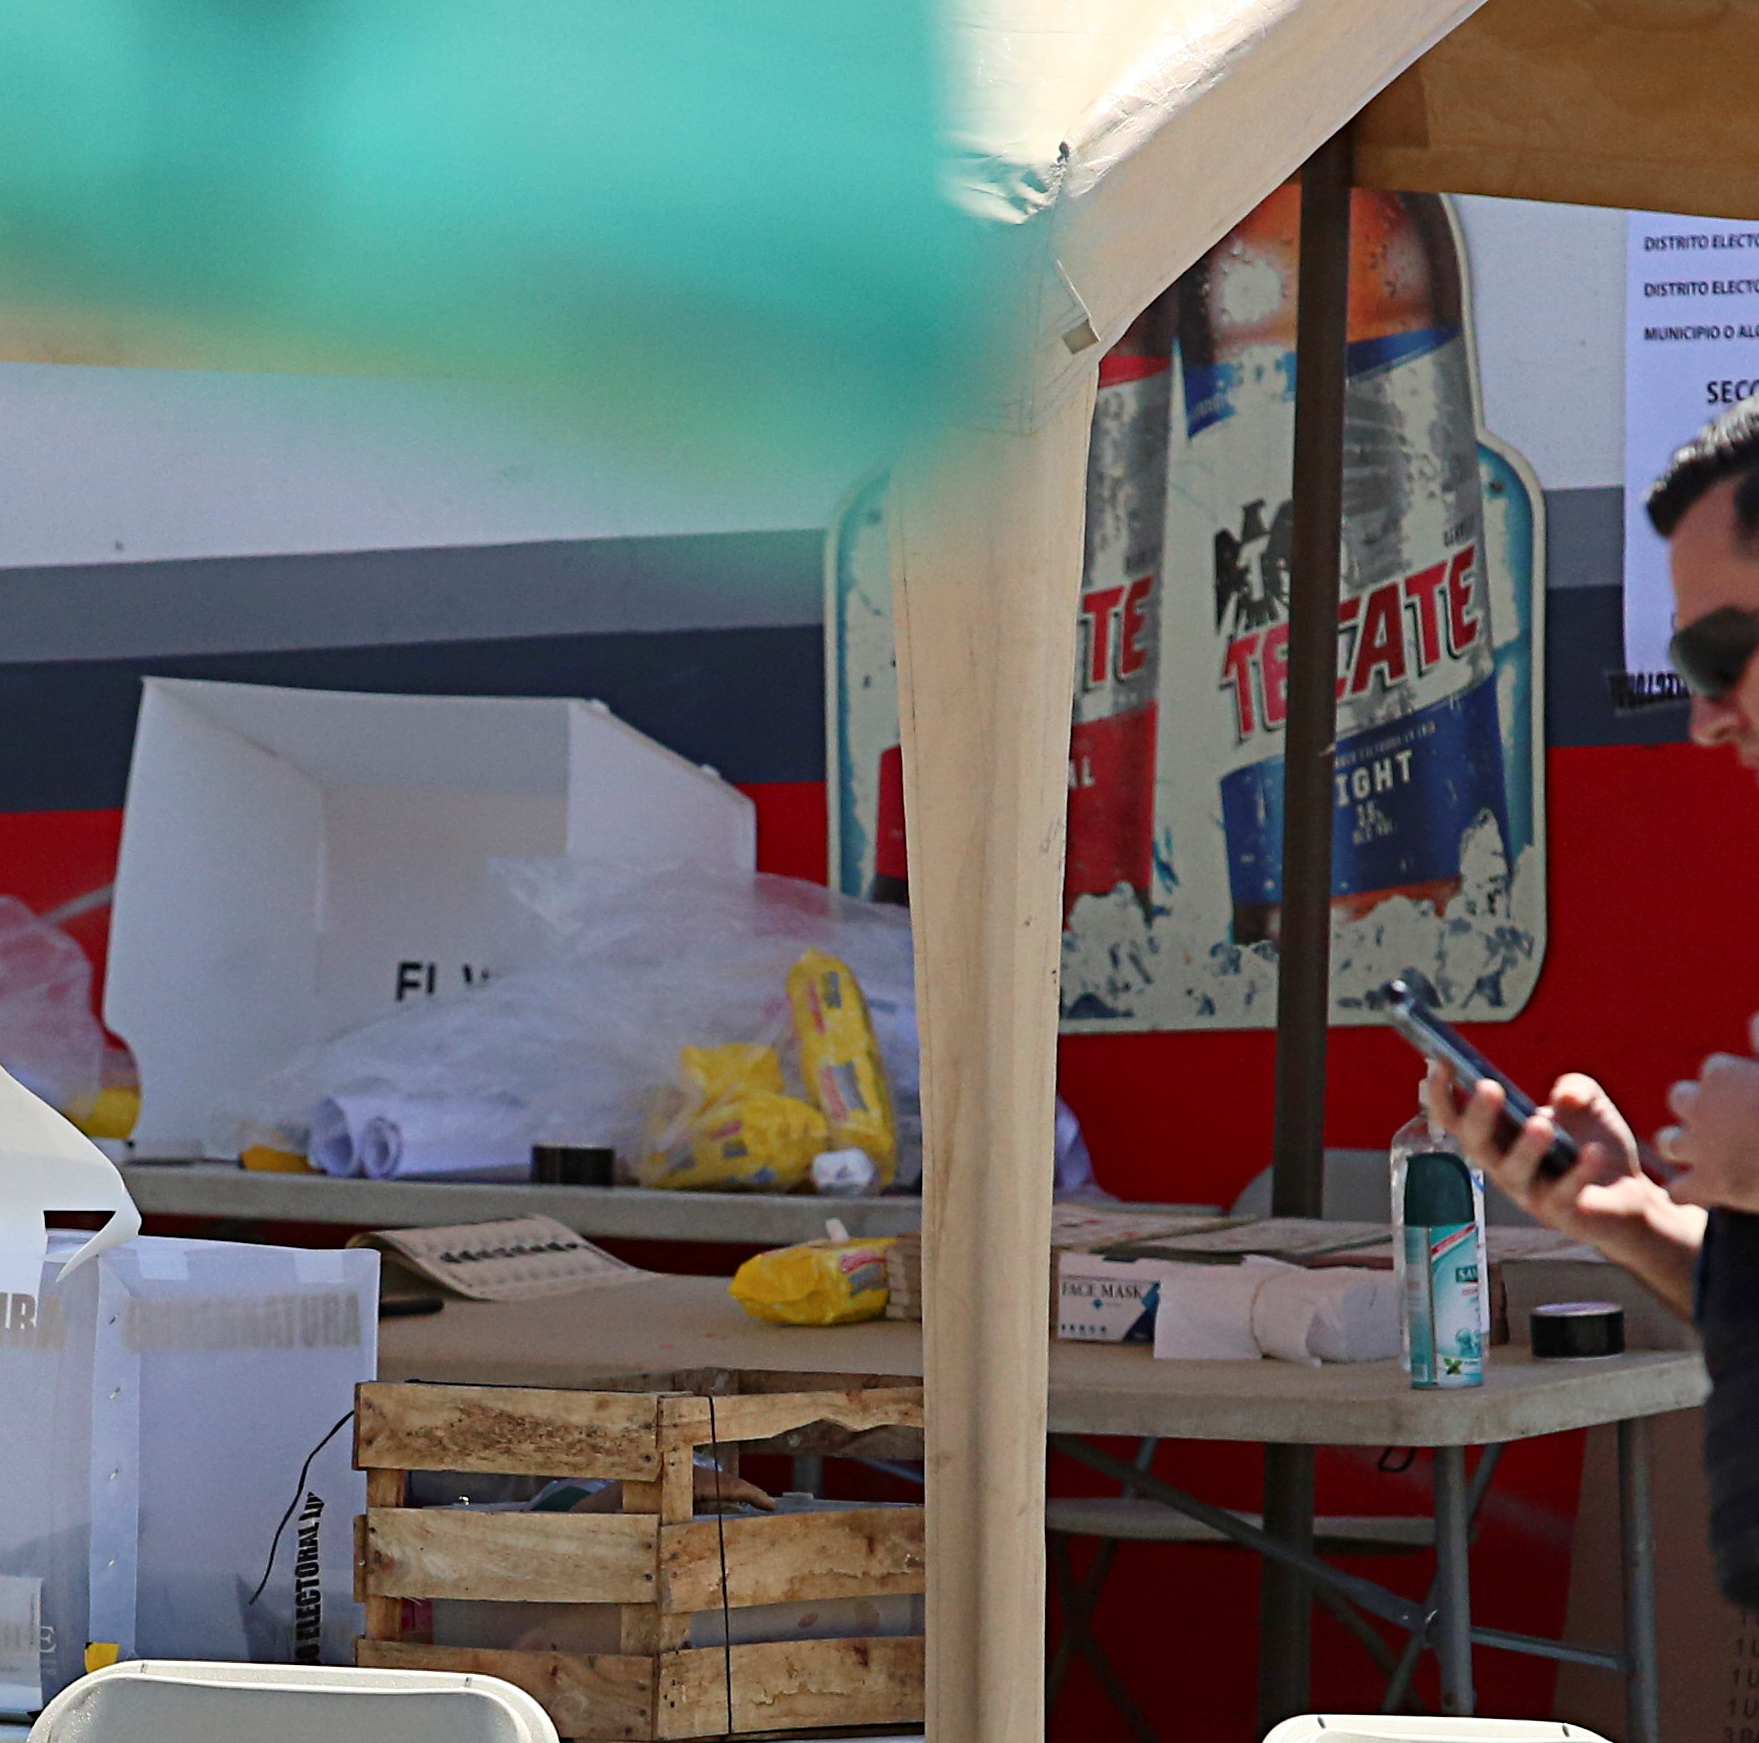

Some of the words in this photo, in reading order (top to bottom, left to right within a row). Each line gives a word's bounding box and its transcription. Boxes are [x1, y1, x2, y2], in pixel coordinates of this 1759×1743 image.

[1644, 235, 1709, 250] DISTRITO
[1644, 281, 1709, 297] DISTRITO
[1643, 325, 1722, 341] MUNICIPIO
[1724, 325, 1735, 339] O
